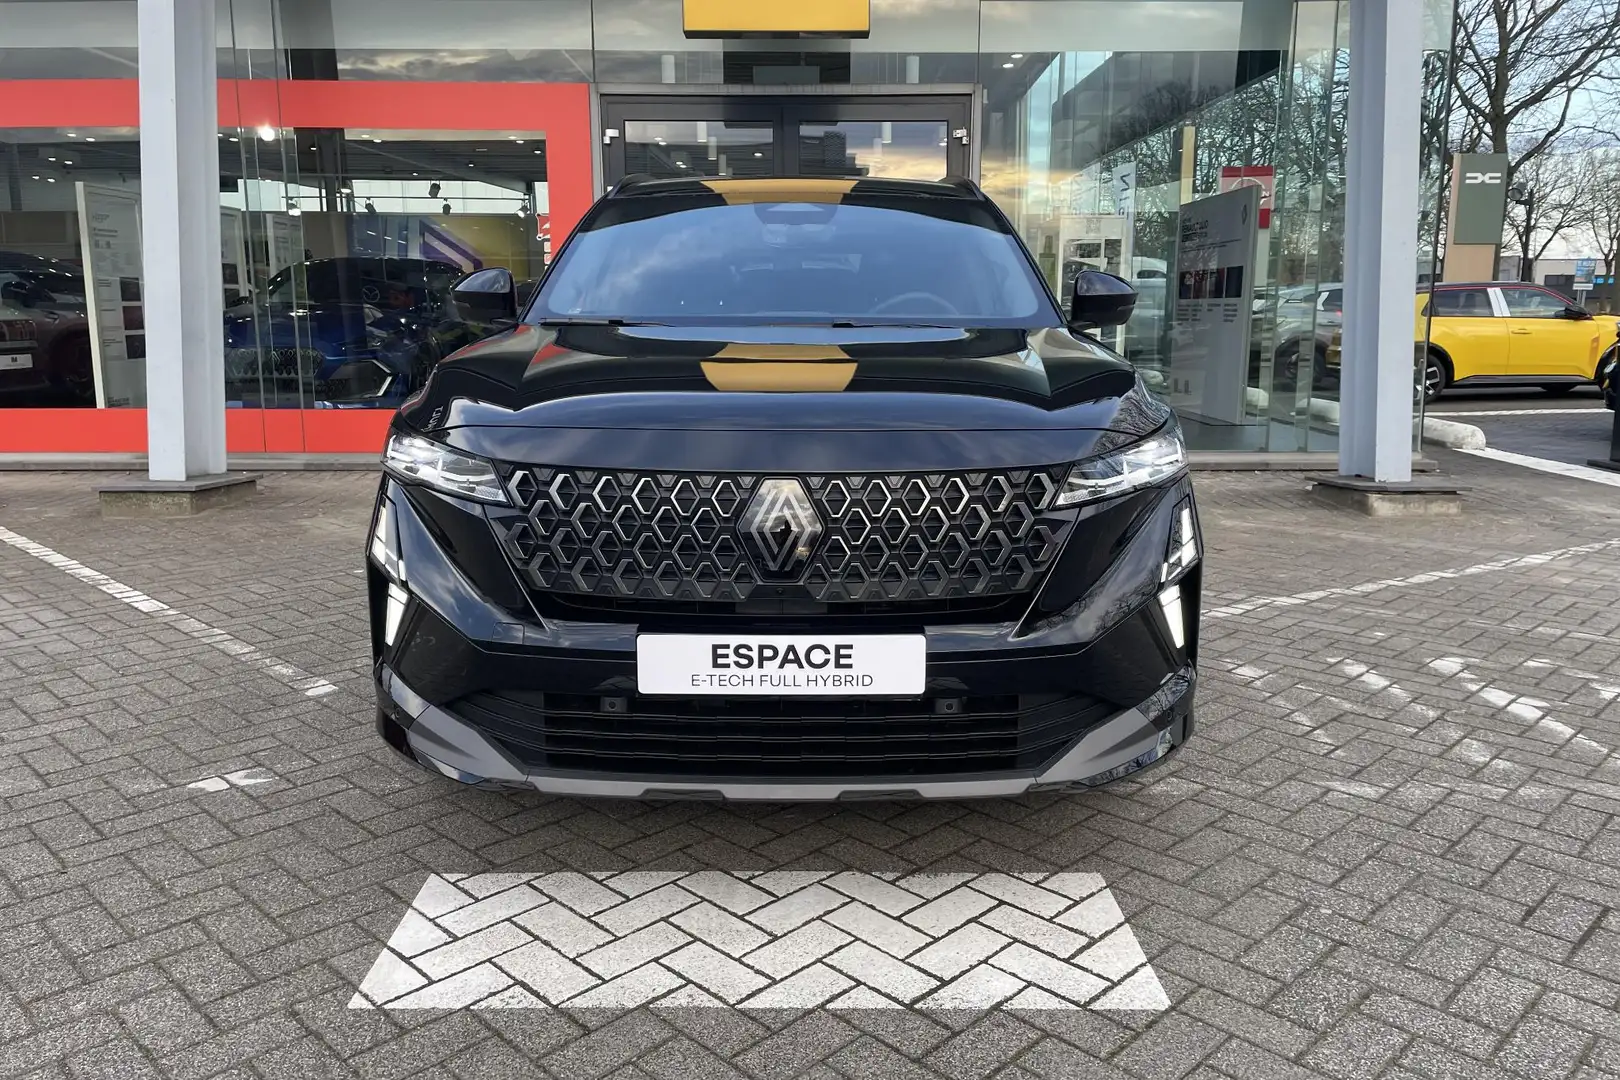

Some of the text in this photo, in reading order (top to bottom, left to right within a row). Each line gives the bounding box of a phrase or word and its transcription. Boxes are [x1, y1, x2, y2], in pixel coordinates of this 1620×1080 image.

[712, 644, 853, 669] ESPACE
[691, 674, 874, 687] E-TECH FULL HYBRID
